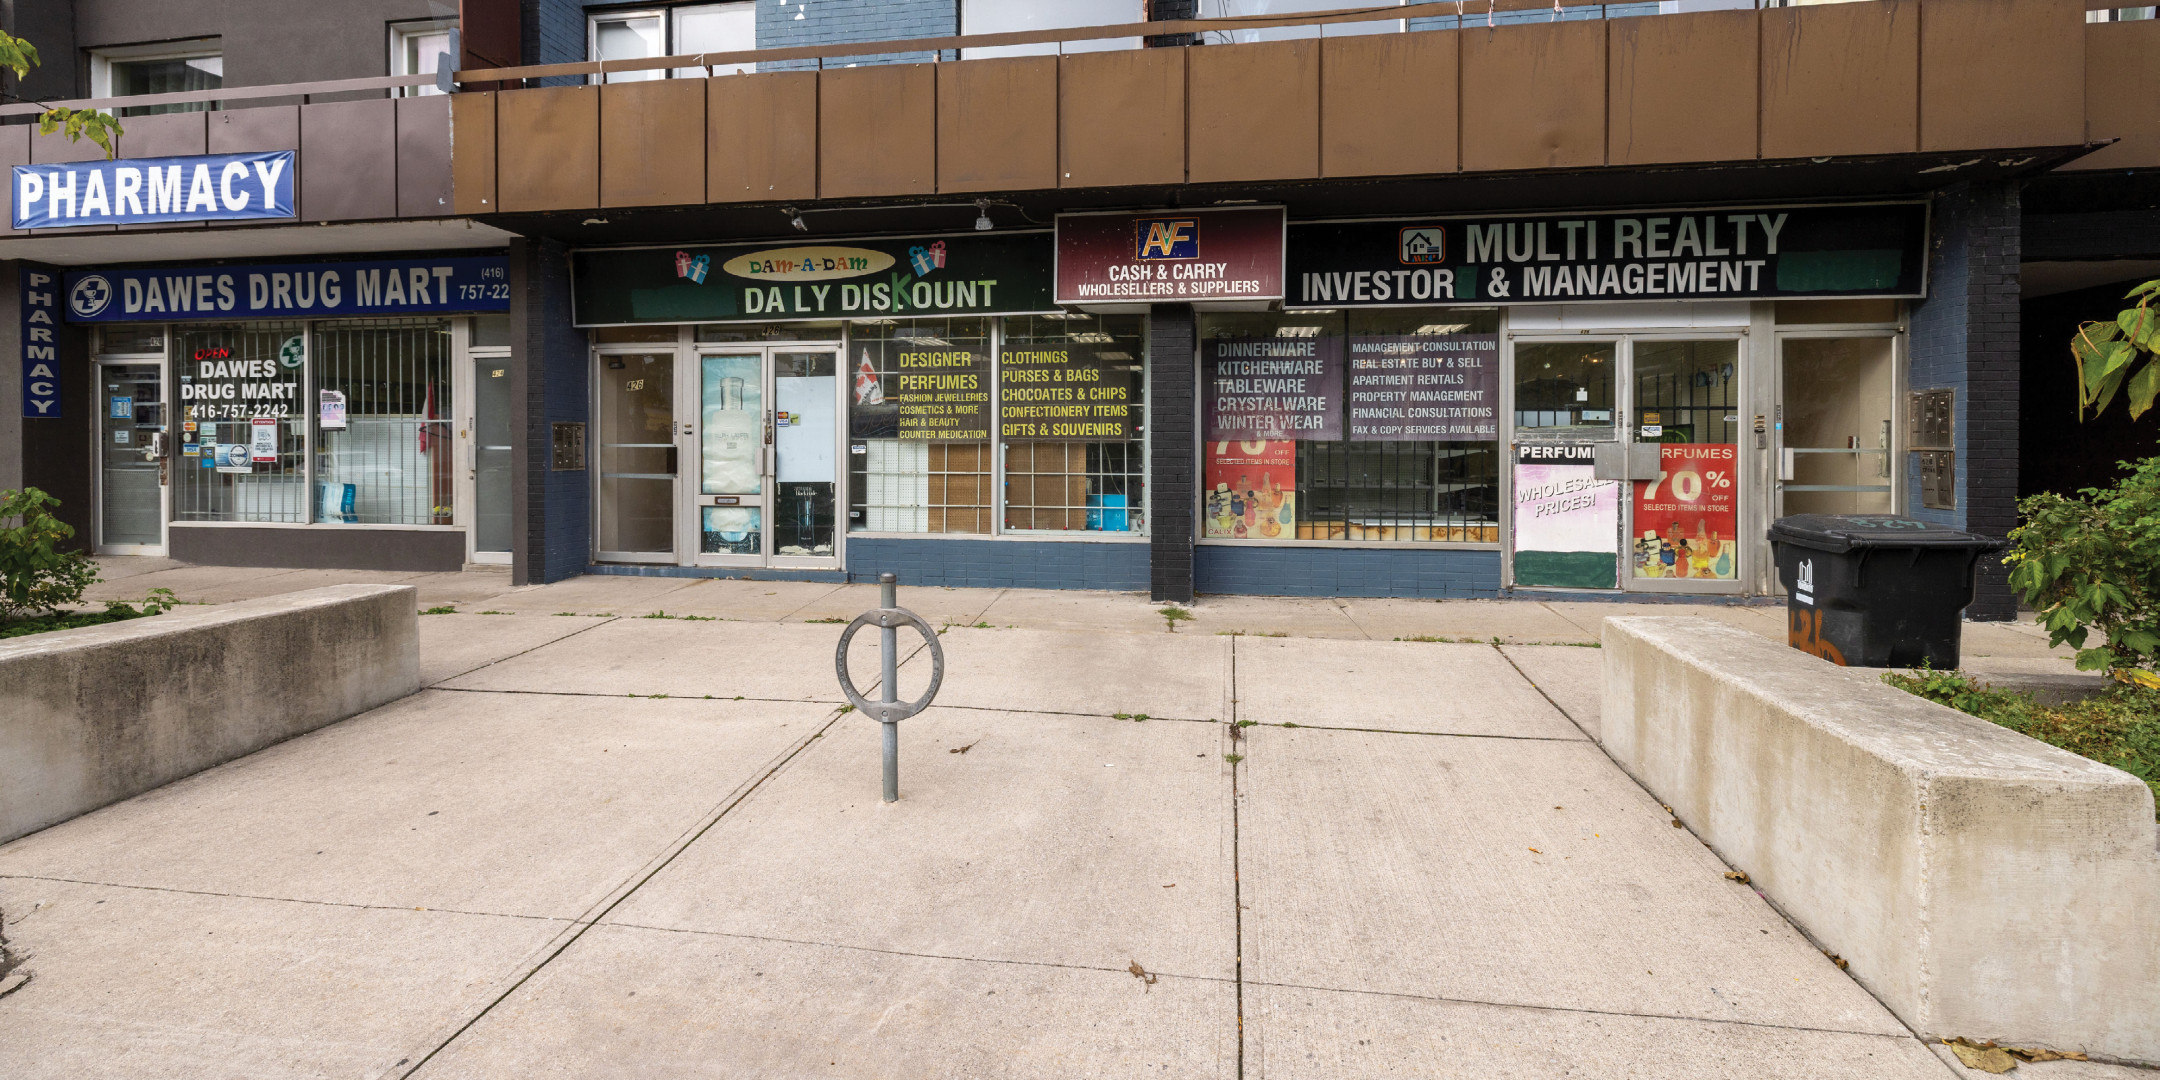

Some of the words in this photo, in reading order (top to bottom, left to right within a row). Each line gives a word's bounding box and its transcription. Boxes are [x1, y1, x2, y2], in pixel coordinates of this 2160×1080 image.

[19, 159, 288, 220] PHARMACY
[1141, 221, 1194, 257] AVF
[1466, 220, 1597, 263] MULTI
[1614, 213, 1788, 260] REALTY
[749, 256, 868, 275] DAM-A-DAM
[1109, 264, 1151, 281] CASH
[1156, 264, 1168, 280] &
[1172, 263, 1228, 280] CARRY
[481, 267, 504, 280] (416)
[1302, 268, 1454, 301] INVESTOR
[1487, 266, 1510, 298] &
[1523, 260, 1766, 297] MANAGEMENT
[123, 274, 236, 314] DAWES
[249, 270, 342, 309] DRUG
[356, 267, 454, 307] MART
[459, 284, 510, 300] 757-22
[841, 272, 998, 313] DISKOUNT
[1078, 282, 1174, 297] WHOLESELLERS
[1177, 282, 1188, 295] &
[1190, 280, 1260, 294] SUPPLIERS
[762, 326, 780, 336] 426
[27, 273, 55, 414] PHARMACY
[1217, 342, 1316, 357] DINNERWARE
[1352, 342, 1420, 353] MANAGEMENT
[1422, 341, 1496, 352] CONSULTATION
[194, 347, 229, 361] OPEN
[900, 351, 972, 368] DESIGNER
[1001, 351, 1068, 365] CLOTHINGS
[200, 359, 277, 378] DAWES
[1217, 360, 1324, 375] KITCHENWARE
[1352, 359, 1379, 369] REAL
[1381, 358, 1419, 369] ESTATE
[1422, 358, 1443, 368] BUY
[1446, 358, 1455, 368] &
[1457, 358, 1483, 368] SELL
[492, 369, 504, 378] 424
[1001, 369, 1050, 383] PURSES
[1053, 369, 1062, 382] &
[1066, 369, 1100, 382] BAGS
[1352, 375, 1414, 386] APARTMENT
[1417, 374, 1464, 385] RENTALS
[627, 380, 643, 390] 426
[900, 374, 978, 390] PERFUMES
[1217, 378, 1306, 394] TABLEWARE
[181, 383, 235, 400] DRUG
[241, 382, 297, 399] MART
[900, 393, 933, 403] FASHION
[935, 393, 989, 403] JEWELLERIES
[1001, 388, 1073, 401] CHOCOATES
[1076, 387, 1086, 401] &
[1089, 387, 1127, 400] CHIPS
[1352, 391, 1407, 402] PROPERTY
[1410, 390, 1484, 402] MANAGEMENT
[900, 405, 945, 415] COSMETICS
[946, 405, 953, 415] &
[955, 405, 979, 415] MORE
[1217, 396, 1327, 411] CRYSTALWARE
[190, 404, 289, 418] 416-757-2242
[1001, 406, 1090, 418] CONFECTIONERY
[1093, 405, 1128, 417] ITEMS
[1352, 408, 1405, 419] FINANCIAL
[1408, 407, 1492, 418] CONSULTATIONS
[900, 417, 919, 427] HAIR
[920, 417, 927, 427] &
[929, 417, 960, 427] BEAUTY
[1002, 423, 1036, 436] GIFTS
[1039, 423, 1049, 436] &
[1052, 422, 1122, 436] SOUVENIRS
[1217, 415, 1274, 430] WINTER
[1279, 415, 1324, 430] WEAR
[900, 430, 936, 439] COUNTER
[938, 430, 987, 439] MEDICATION
[1352, 425, 1368, 435] FAX
[1371, 425, 1378, 435] &
[1380, 425, 1403, 435] COPY
[1405, 425, 1447, 434] SERVICES
[1450, 425, 1496, 434] AVAILABLE
[1520, 446, 1595, 459] PERFUM
[1661, 448, 1733, 459] RFUMES
[1270, 458, 1290, 466] STORE
[1643, 470, 1702, 501] 70
[1705, 471, 1731, 488] %
[1712, 494, 1729, 502] OFF
[1535, 493, 1596, 518] PRICES!
[1643, 503, 1677, 511] SELECTED
[1678, 504, 1698, 512] ITEMS
[1699, 504, 1706, 512] IN
